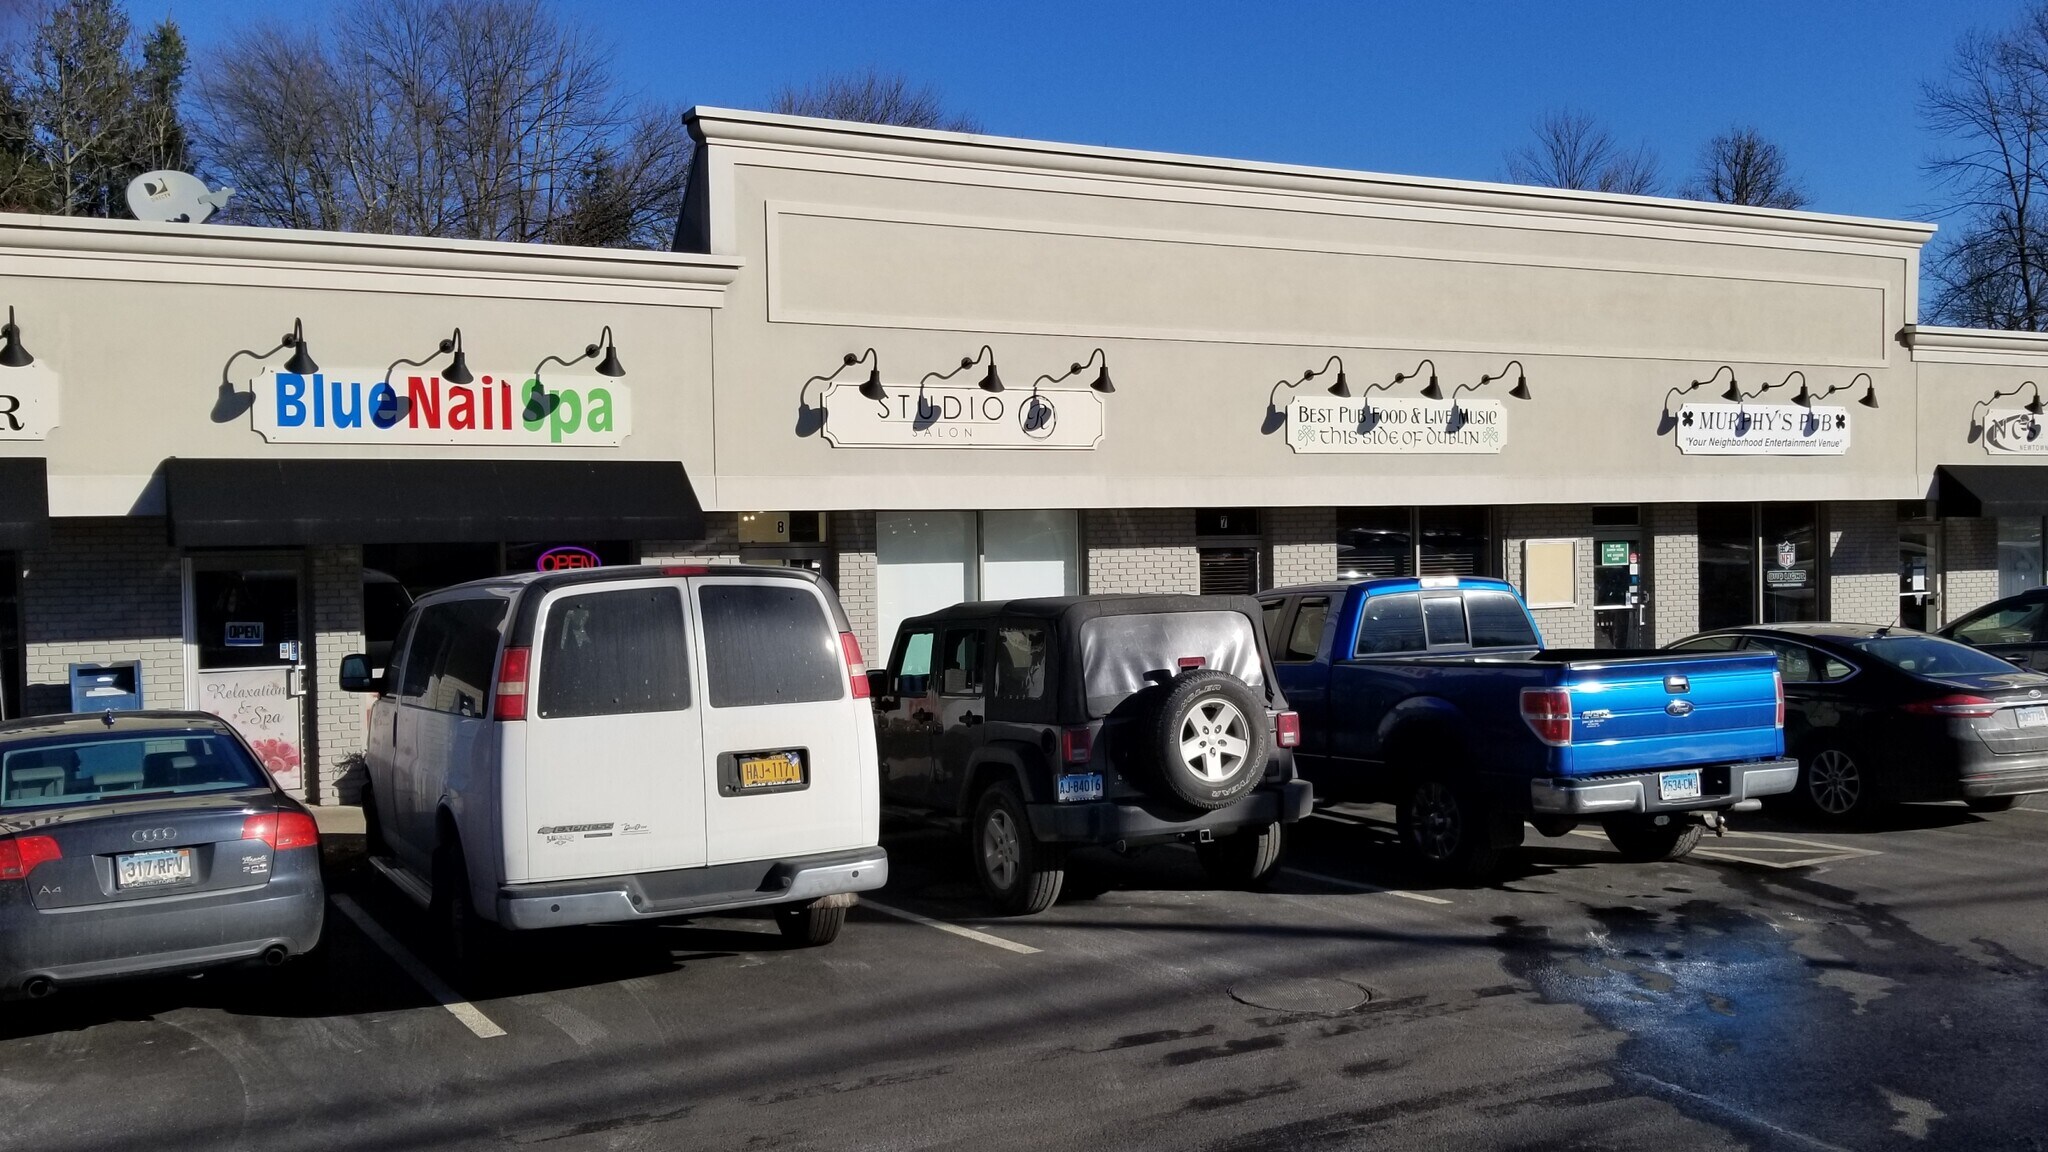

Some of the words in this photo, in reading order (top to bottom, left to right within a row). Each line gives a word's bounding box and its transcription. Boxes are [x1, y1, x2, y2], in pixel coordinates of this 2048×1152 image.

[276, 373, 397, 429] Blue
[408, 375, 512, 431] Nail
[522, 379, 613, 443] Spa
[877, 395, 1004, 421] STUDIO
[1299, 406, 1333, 423] BEST
[1340, 406, 1367, 424] PUB
[1372, 407, 1407, 424] FOOD
[1411, 408, 1421, 424] &
[1425, 408, 1453, 424] LIVE
[1459, 408, 1497, 425] MUSIC
[1699, 410, 1793, 431] MURPHY'S
[1799, 413, 1832, 431] PUB
[912, 427, 973, 438] SALON
[1709, 437, 1763, 448] Neighborhood
[1764, 438, 1816, 447] Entertainment
[777, 520, 785, 534] 8
[1221, 516, 1228, 529] 7
[541, 555, 595, 571] OPEN
[1781, 553, 1794, 565] NFL
[229, 625, 261, 639] OPEN
[207, 682, 286, 699] Relaxation
[250, 706, 281, 727] Spa
[1211, 735, 1265, 798] GOODYEAR
[38, 885, 61, 895] A4
